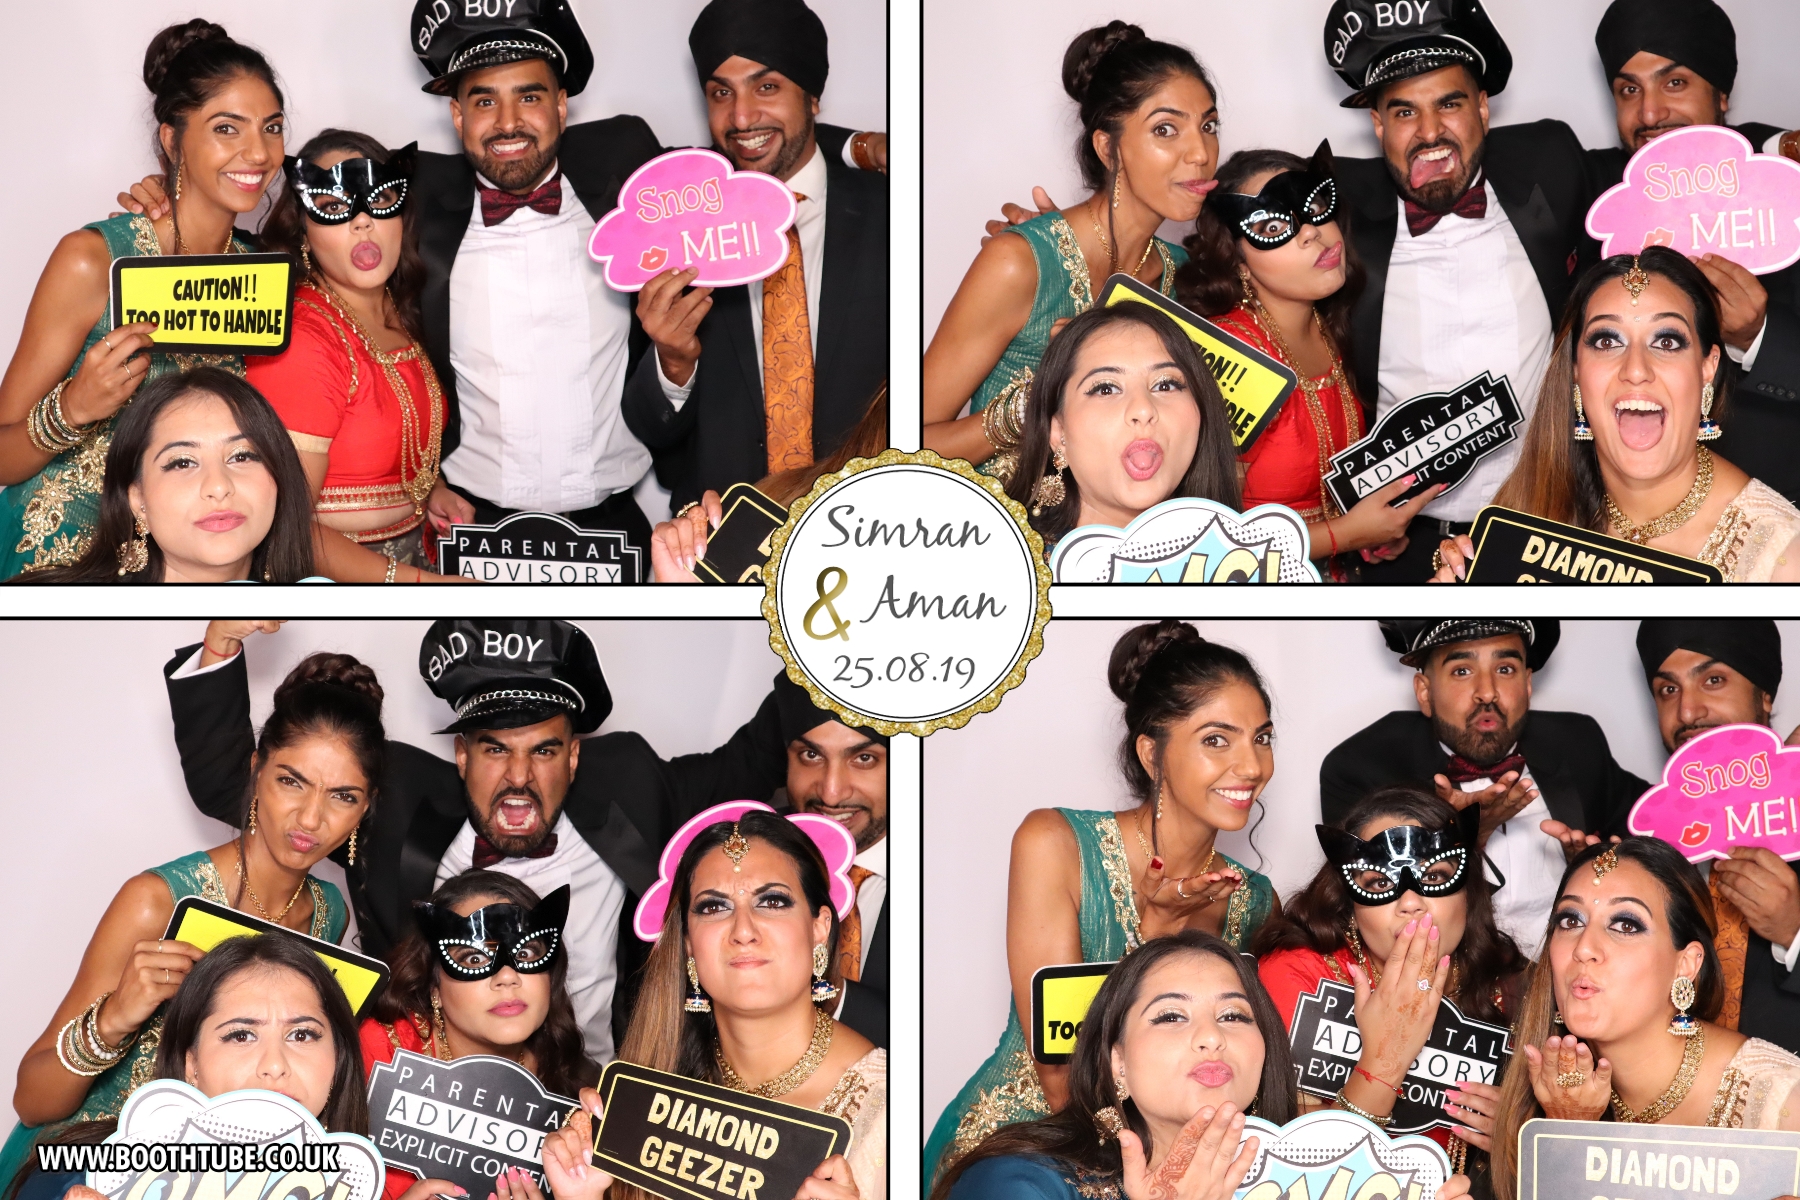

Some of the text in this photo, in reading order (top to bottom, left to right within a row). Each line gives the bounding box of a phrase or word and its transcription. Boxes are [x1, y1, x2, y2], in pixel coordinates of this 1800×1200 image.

[419, 0, 518, 50] BAD BOY
[1333, 0, 1430, 64] BAD BOY
[637, 177, 723, 223] Snog
[1644, 158, 1739, 202] Snog
[680, 221, 761, 265] ME!!
[1690, 207, 1776, 249] ME!!
[173, 274, 257, 302] CAUTION!!
[164, 309, 197, 331] HOT
[200, 309, 221, 332] TO
[224, 309, 282, 335] HANDLE
[1343, 384, 1492, 475] PARENTAL
[1357, 400, 1498, 495] ADVISORY
[1433, 421, 1506, 471] CONTENT
[459, 537, 621, 560] PARENTAL
[462, 560, 620, 583] ADVISORY
[429, 629, 544, 682] BAD BOY
[1681, 751, 1771, 798] Snog
[398, 1066, 559, 1129] PARENTA
[379, 1127, 469, 1168] EXPLICIT
[388, 1095, 546, 1159] ADVISO
[647, 1093, 779, 1160] DIAMOND
[640, 1136, 764, 1200] GEEZER
[1585, 1145, 1740, 1195] DIAMOND
